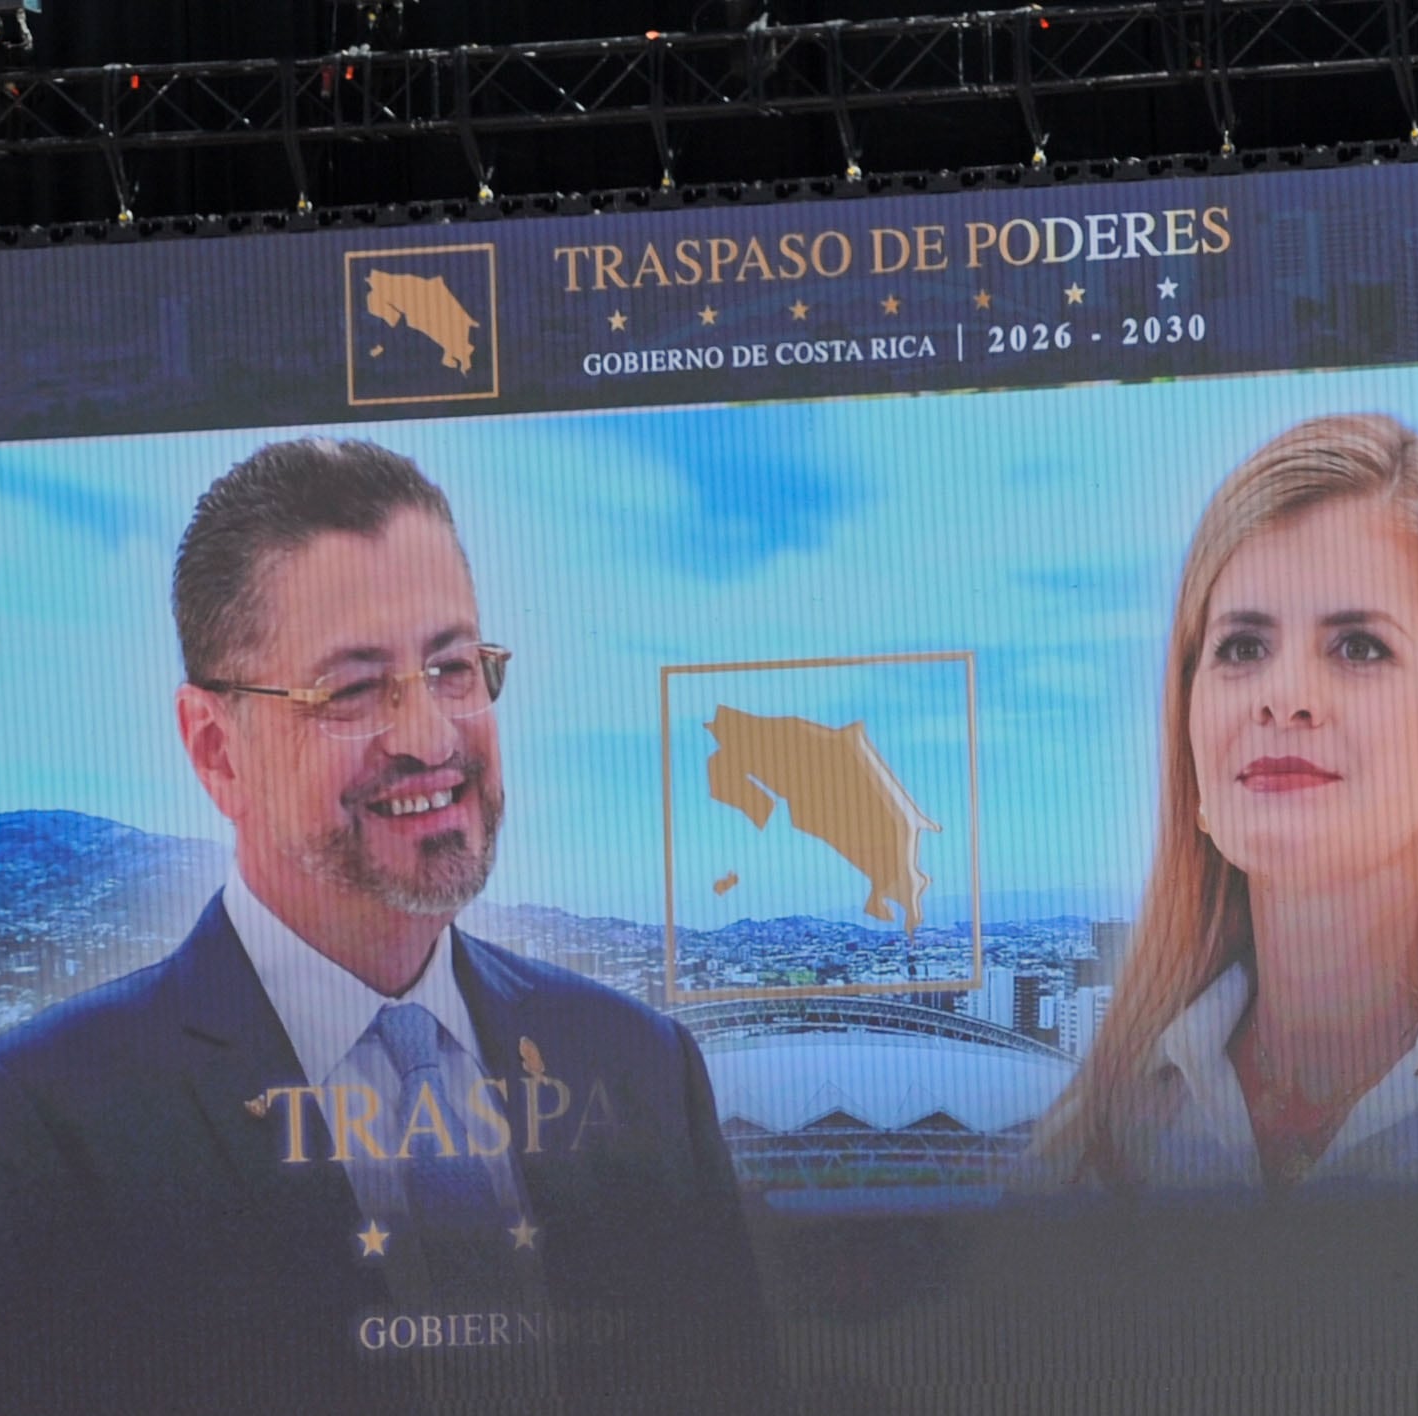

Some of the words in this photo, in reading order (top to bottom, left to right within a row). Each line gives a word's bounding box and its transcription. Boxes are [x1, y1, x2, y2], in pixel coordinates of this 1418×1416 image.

[553, 231, 853, 293] TRASPASO
[868, 224, 949, 275] DE
[965, 206, 1233, 268] PODERES
[582, 343, 724, 377] GOBIERNO
[729, 341, 770, 369] DE
[776, 339, 864, 366] COSTA
[870, 334, 937, 363] RICA
[987, 323, 1073, 354] 2026
[1121, 313, 1208, 345] 2030
